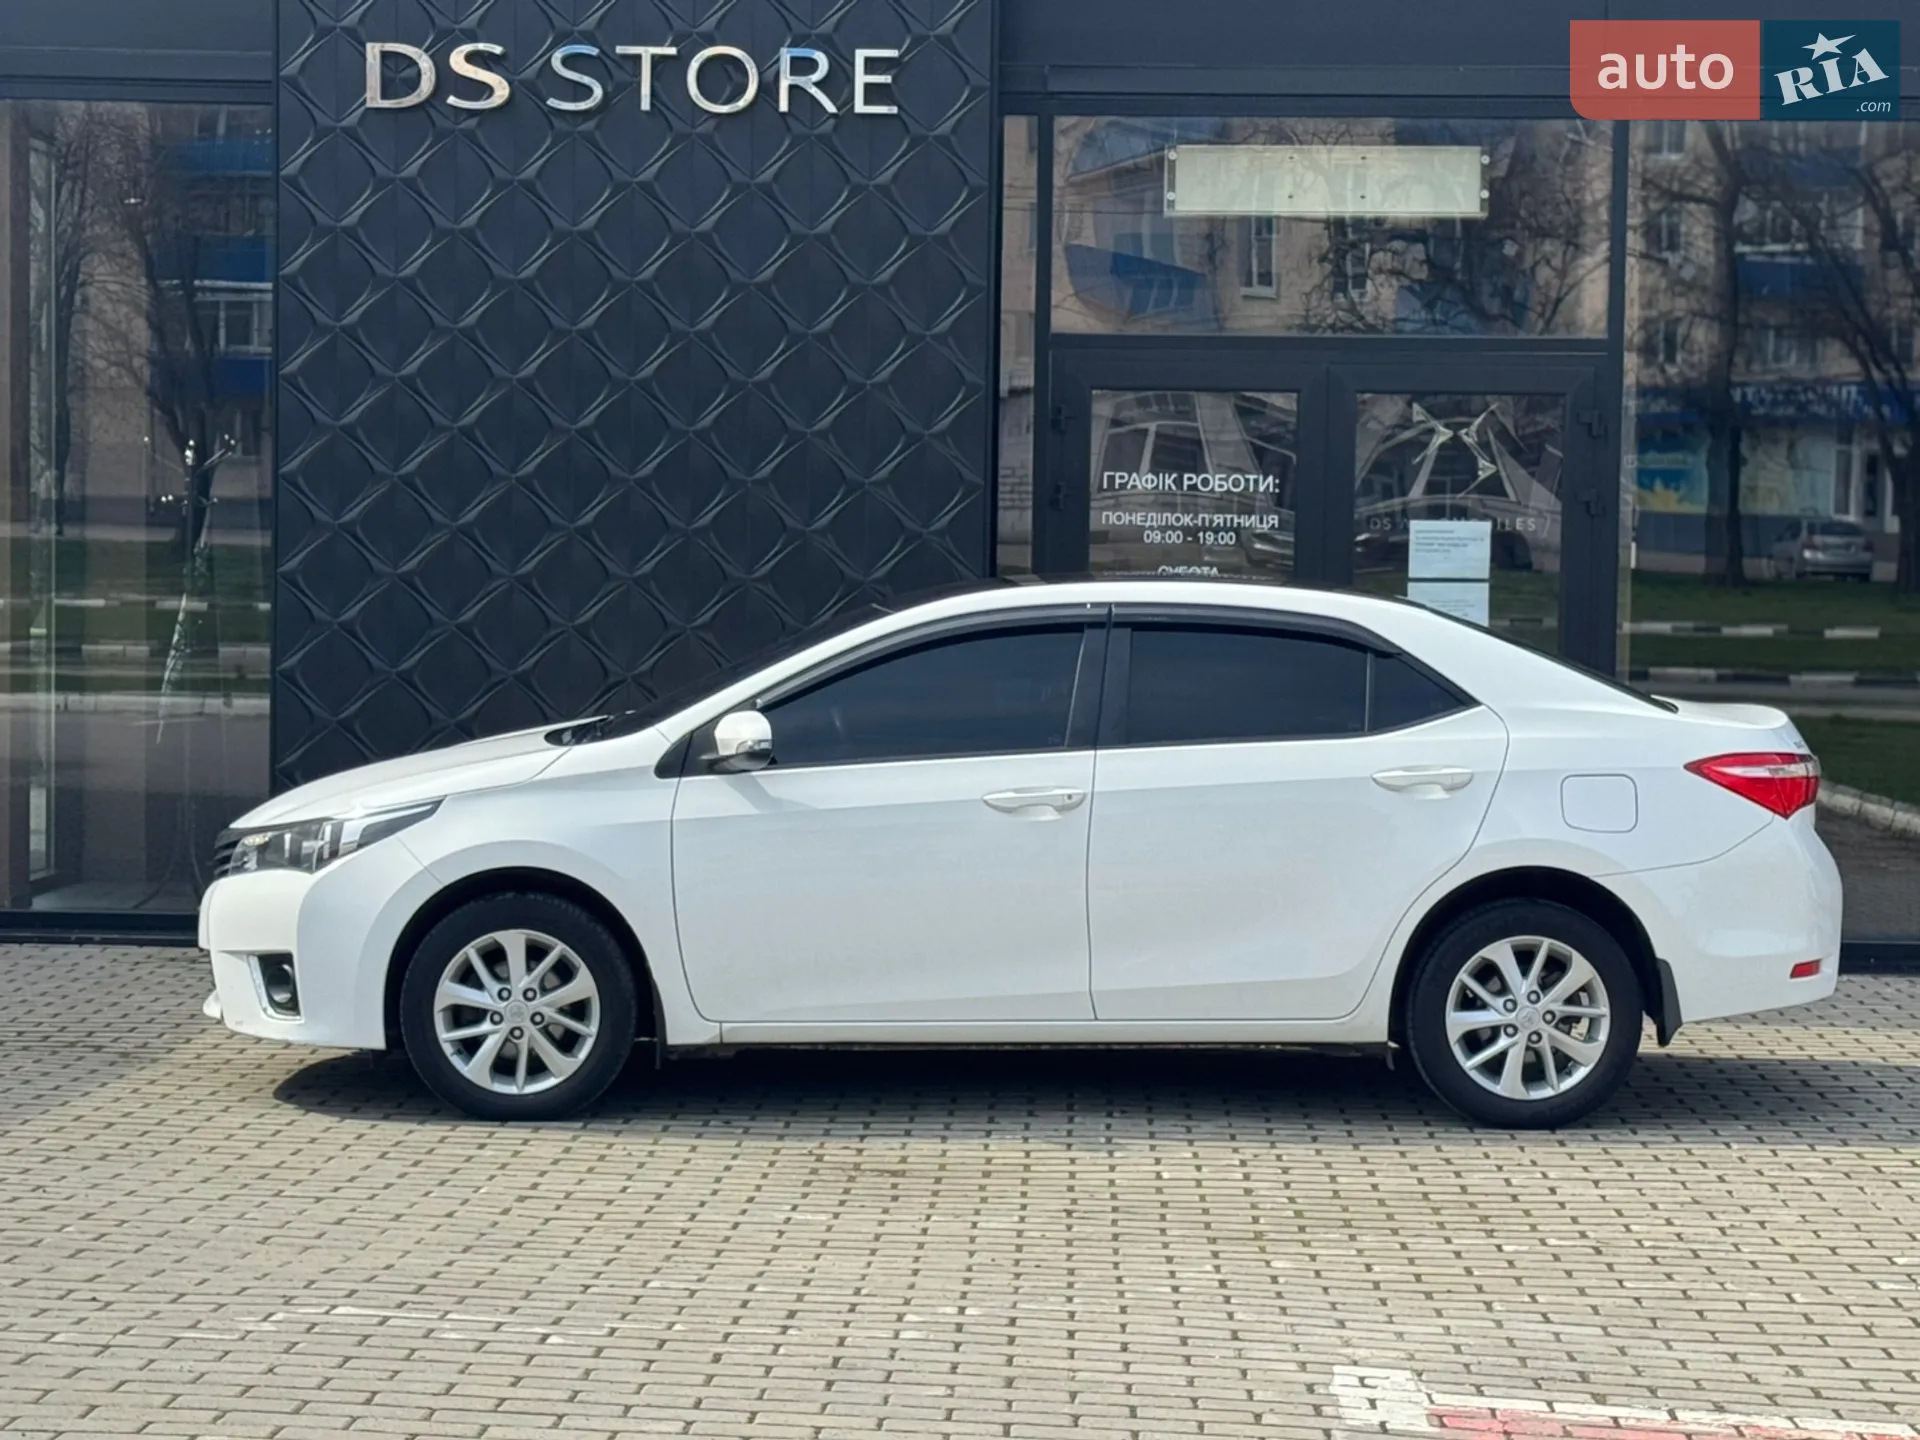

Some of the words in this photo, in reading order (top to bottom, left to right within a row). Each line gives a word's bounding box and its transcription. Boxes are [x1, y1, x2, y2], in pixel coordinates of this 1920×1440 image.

[365, 42, 512, 111] DS
[546, 44, 900, 115] STORE
[1102, 471, 1177, 491] ГРАФІК
[1182, 473, 1281, 494] РОБОТИ:
[1101, 511, 1280, 531] ПОНЕДІЛОК-П'ЯТНИЦЯ
[1369, 517, 1392, 531] DS
[1143, 530, 1184, 545] 09:00
[1197, 531, 1237, 546] 19:00
